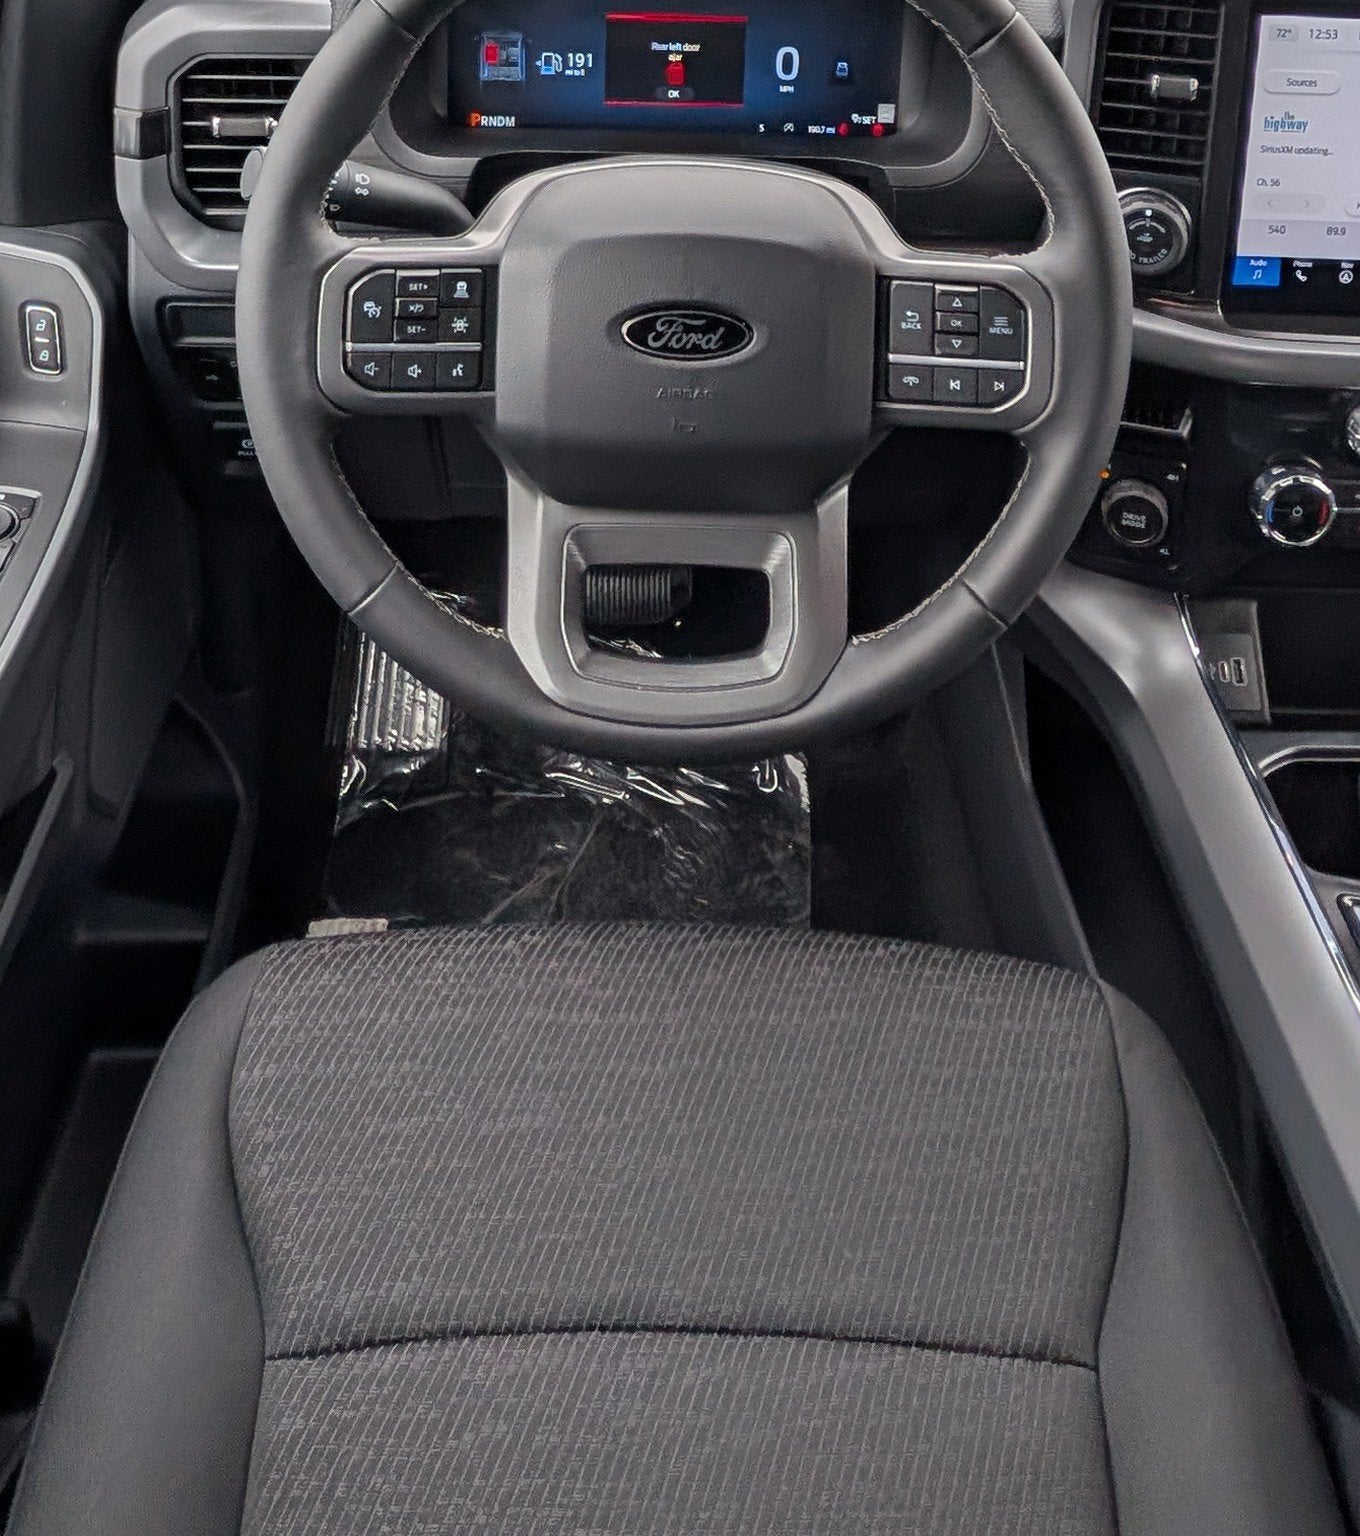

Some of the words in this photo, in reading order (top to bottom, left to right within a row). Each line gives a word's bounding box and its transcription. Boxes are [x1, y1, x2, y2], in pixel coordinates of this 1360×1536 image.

[1309, 28, 1339, 40] 12:53
[669, 42, 682, 52] left
[683, 42, 700, 52] door
[567, 52, 593, 68] 191
[775, 46, 800, 81] 0
[1286, 78, 1318, 88] Sources
[667, 90, 680, 99] OK
[1263, 116, 1309, 133] highway
[1260, 145, 1293, 154] SiriusXM
[1269, 178, 1281, 187] 56
[1268, 224, 1287, 235] 540
[1326, 225, 1347, 236] 89.9
[1249, 259, 1268, 267] Audio
[901, 322, 923, 330] BACK
[950, 319, 963, 327] OK
[647, 316, 726, 350] Ford
[989, 327, 1014, 335] MENU
